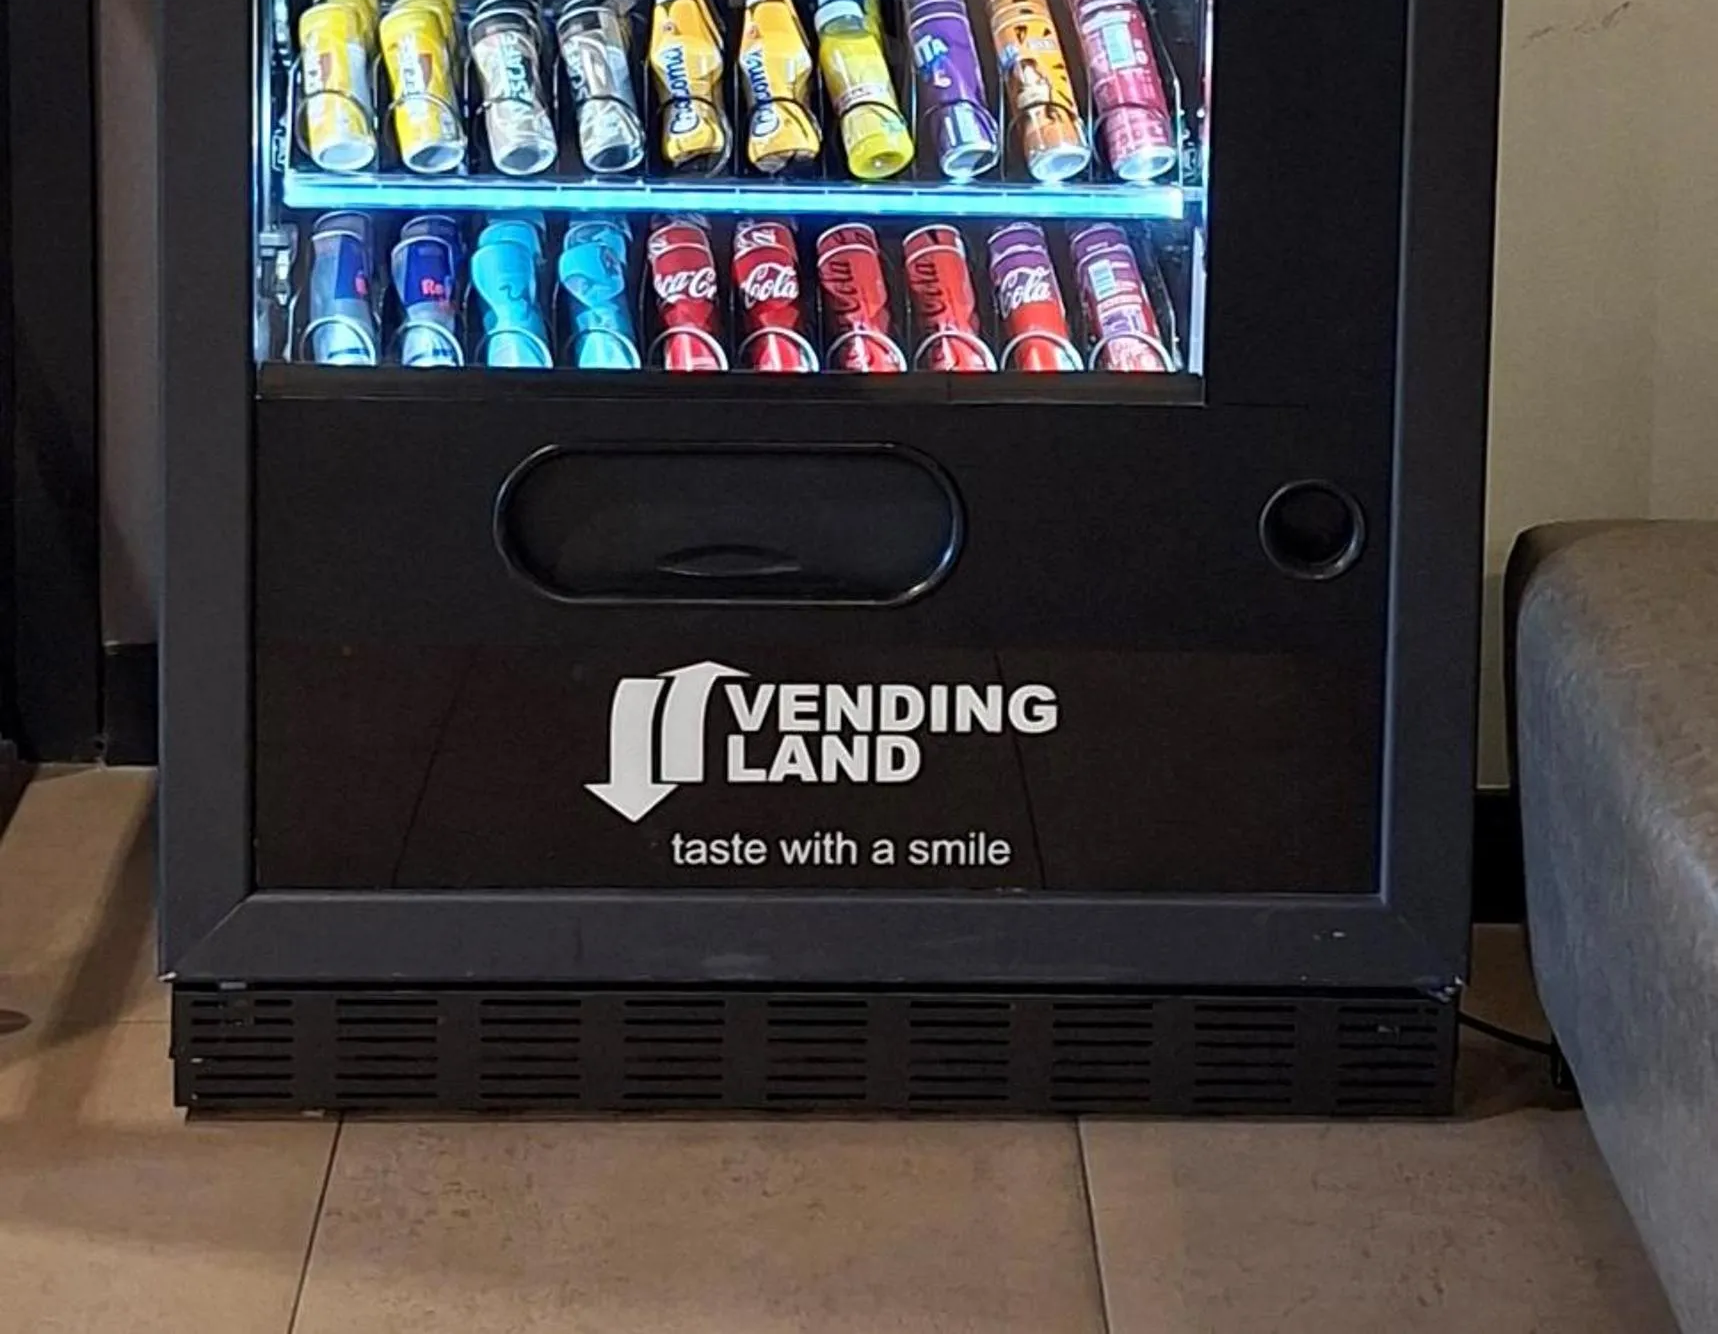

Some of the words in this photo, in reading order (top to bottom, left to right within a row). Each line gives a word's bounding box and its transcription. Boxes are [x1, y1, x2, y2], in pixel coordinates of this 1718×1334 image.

[725, 684, 1059, 733] VENDING
[727, 735, 921, 783] LAND
[671, 833, 767, 865] taste
[779, 831, 857, 865] with
[871, 840, 895, 865] a
[908, 832, 1011, 865] smile
